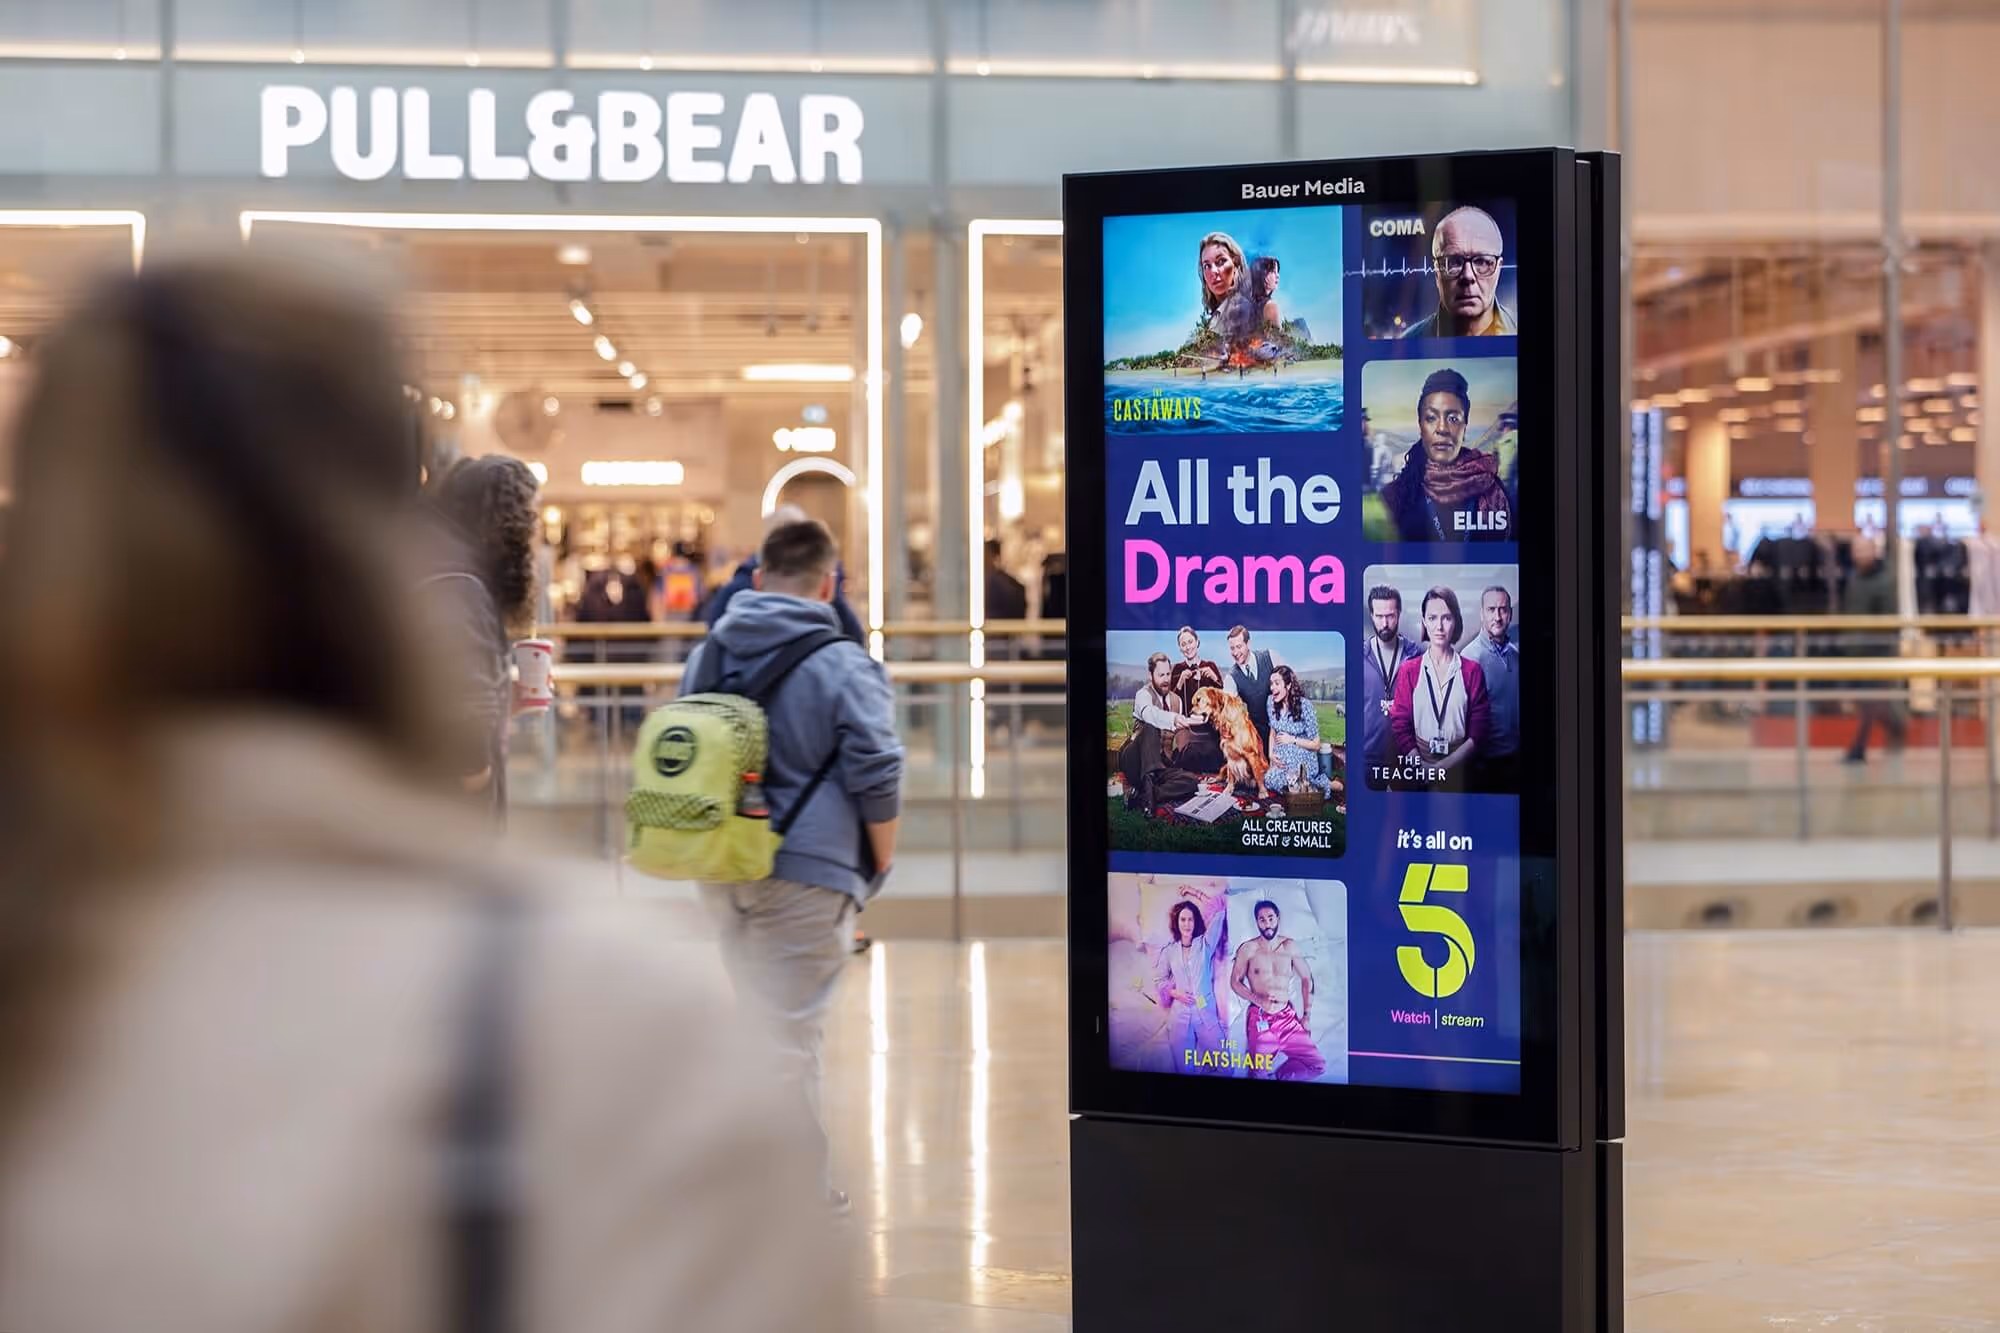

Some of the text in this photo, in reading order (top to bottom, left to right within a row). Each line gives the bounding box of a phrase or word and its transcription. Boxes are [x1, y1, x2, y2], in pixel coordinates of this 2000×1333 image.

[260, 85, 865, 184] PULL&BEAR
[1241, 177, 1366, 200] Bauer Media
[1369, 218, 1426, 238] COMA
[1113, 396, 1202, 422] CASTAWAYS
[1124, 456, 1342, 526] All the
[1453, 510, 1508, 531] ELLIS
[1124, 539, 1346, 605] Drama
[1397, 754, 1422, 766] THE
[1372, 767, 1447, 781] TEACHER
[1241, 819, 1333, 834] ALL CREATURES
[1241, 833, 1280, 847] GREAT
[1293, 835, 1332, 849] SMALL
[1425, 831, 1446, 850] all
[1449, 835, 1473, 851] on
[1396, 863, 1475, 998] 5
[1390, 1009, 1484, 1027] Watch stream
[1219, 1039, 1239, 1050] THE
[1184, 1049, 1275, 1070] FLATSHARE
